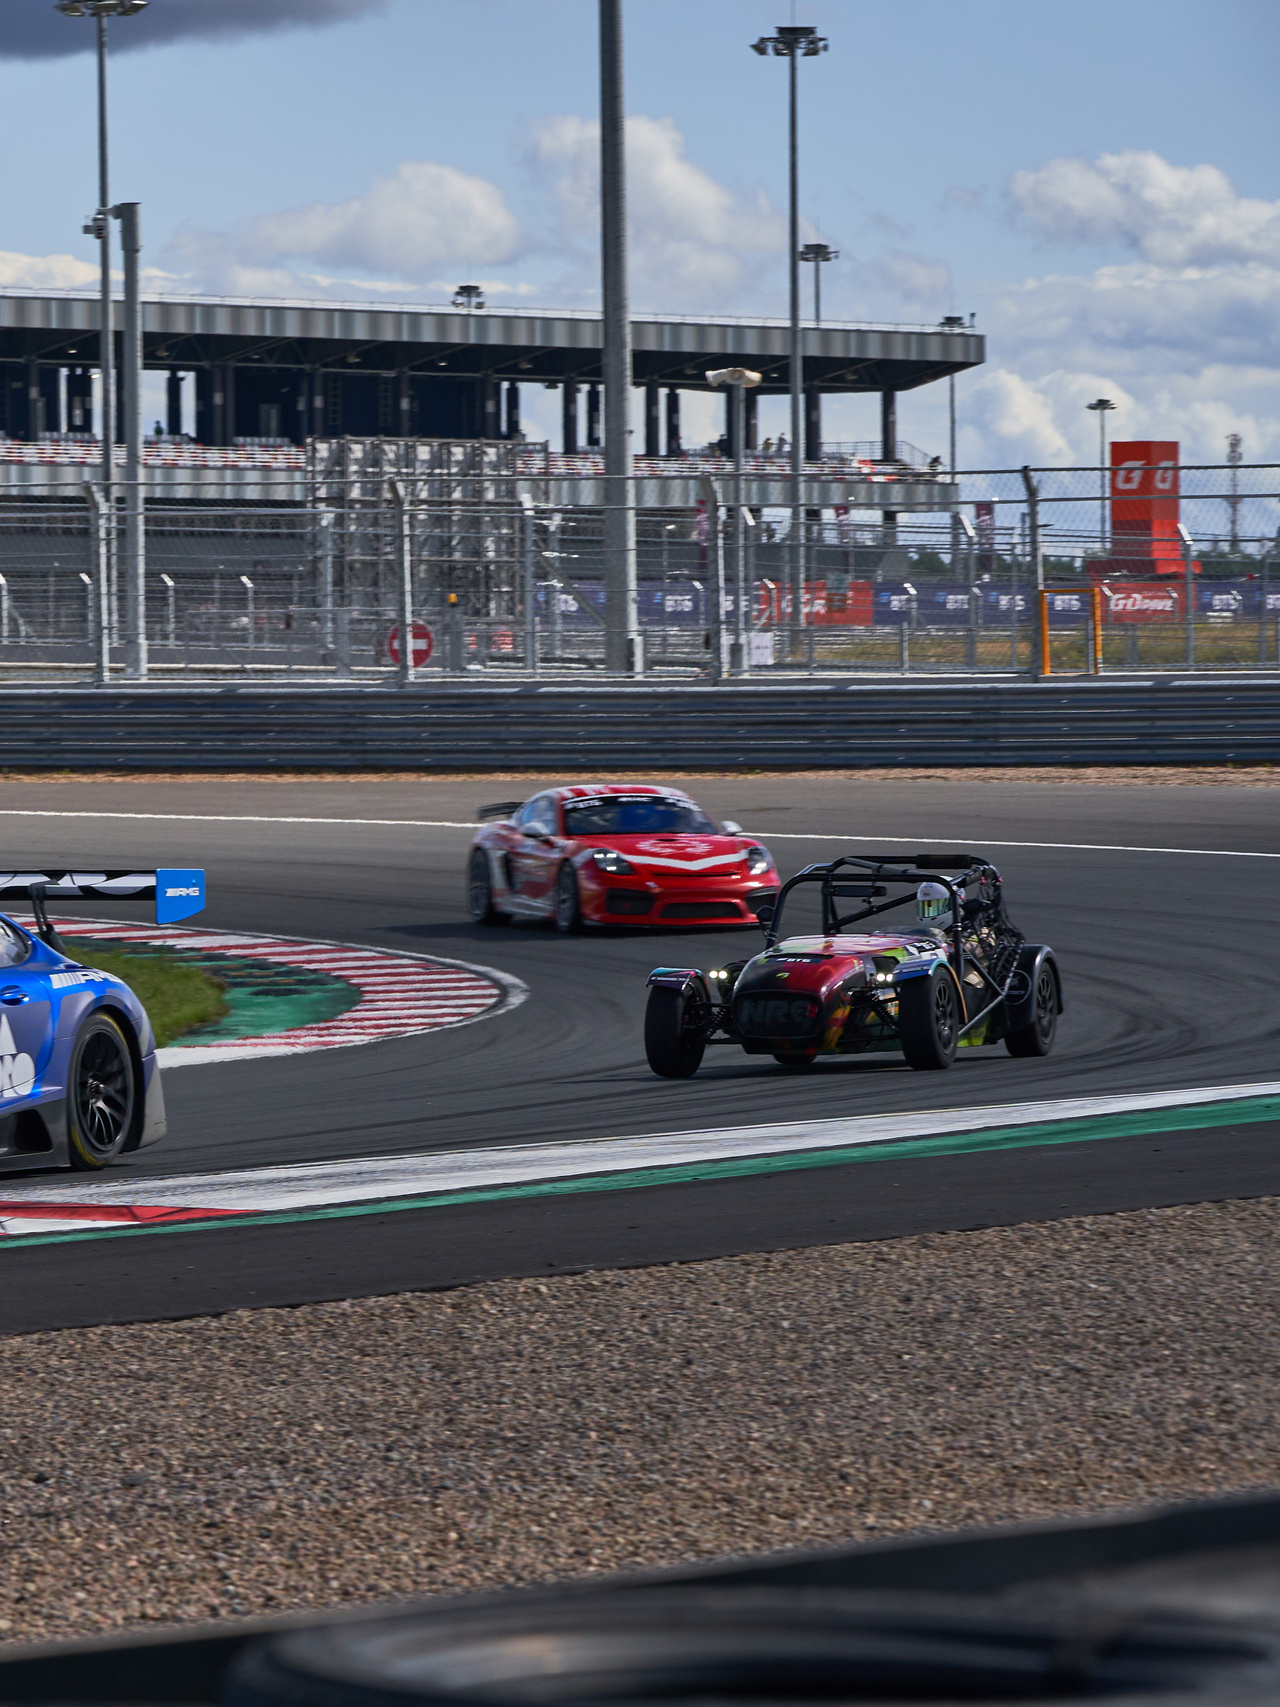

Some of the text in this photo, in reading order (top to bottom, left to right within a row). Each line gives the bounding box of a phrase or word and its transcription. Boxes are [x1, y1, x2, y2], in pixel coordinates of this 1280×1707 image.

[1115, 460, 1147, 490] G
[1154, 460, 1176, 490] G
[172, 887, 199, 897] AMG
